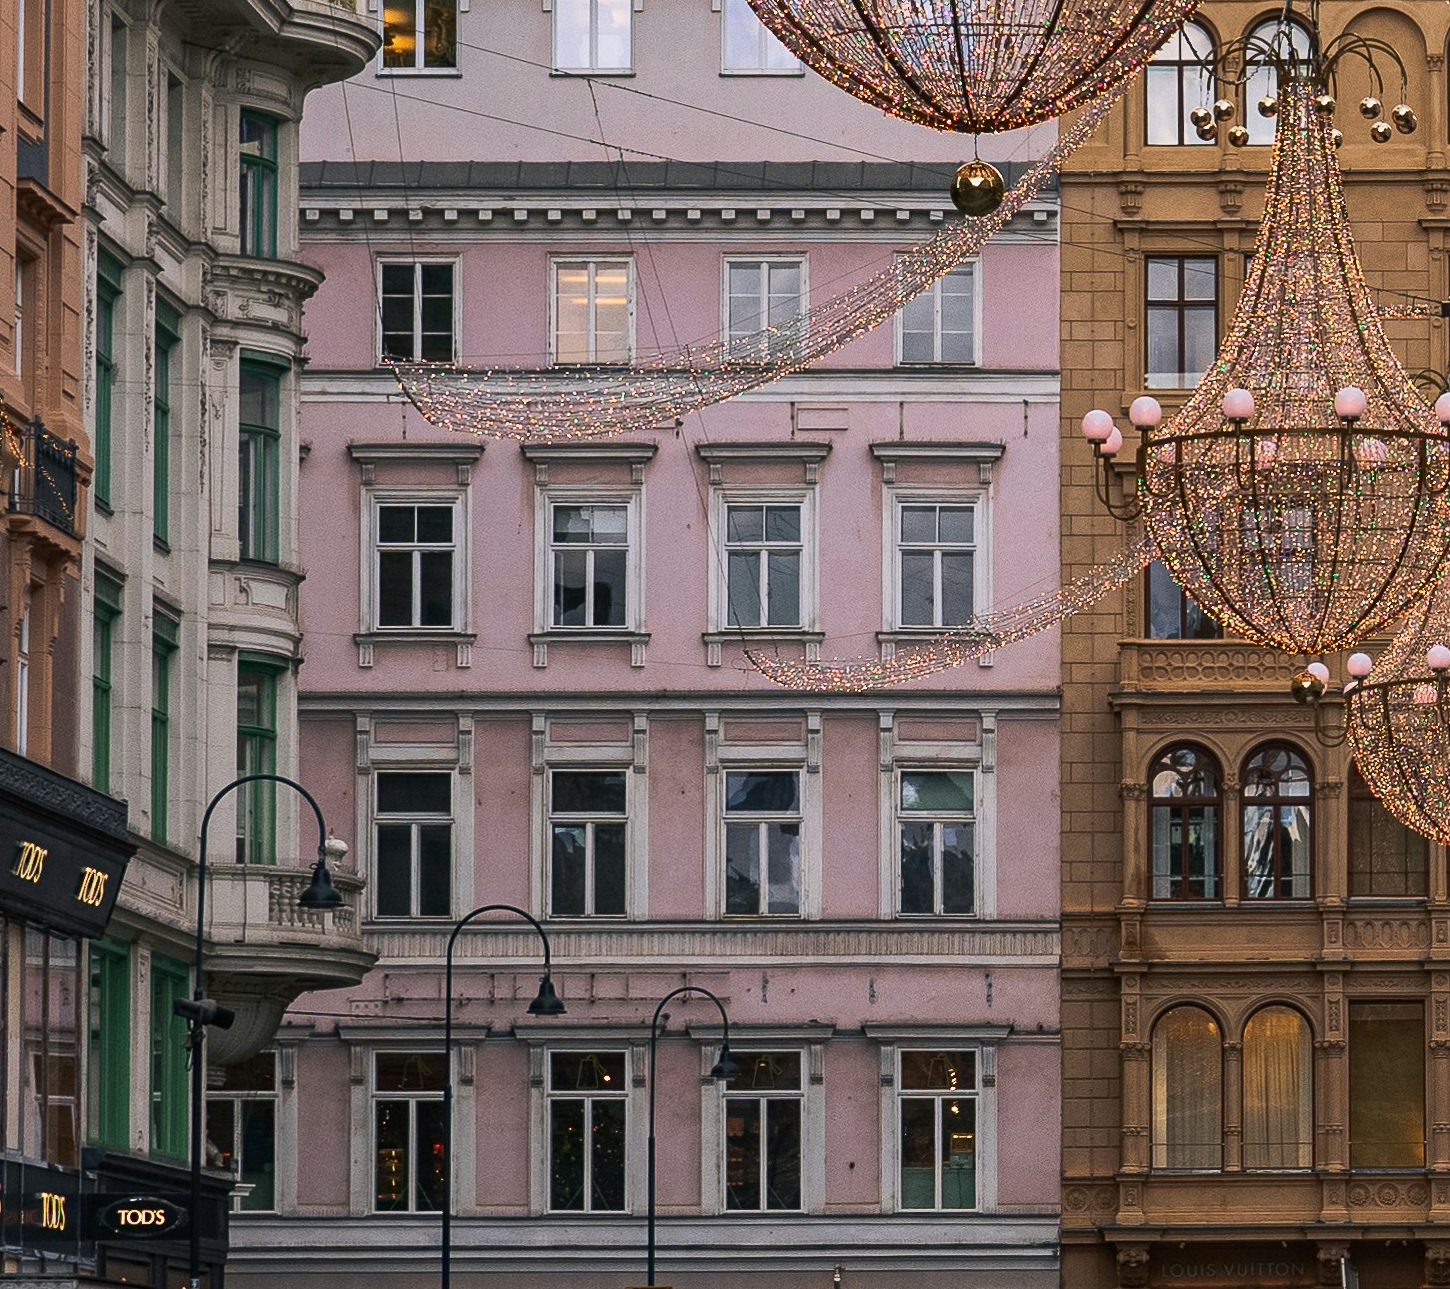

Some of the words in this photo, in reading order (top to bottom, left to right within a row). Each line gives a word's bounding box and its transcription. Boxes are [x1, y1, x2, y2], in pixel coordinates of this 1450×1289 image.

[117, 1209, 166, 1225] TOD'S
[1161, 1263, 1216, 1279] LOUIS
[1223, 1262, 1305, 1278] VUITTON
